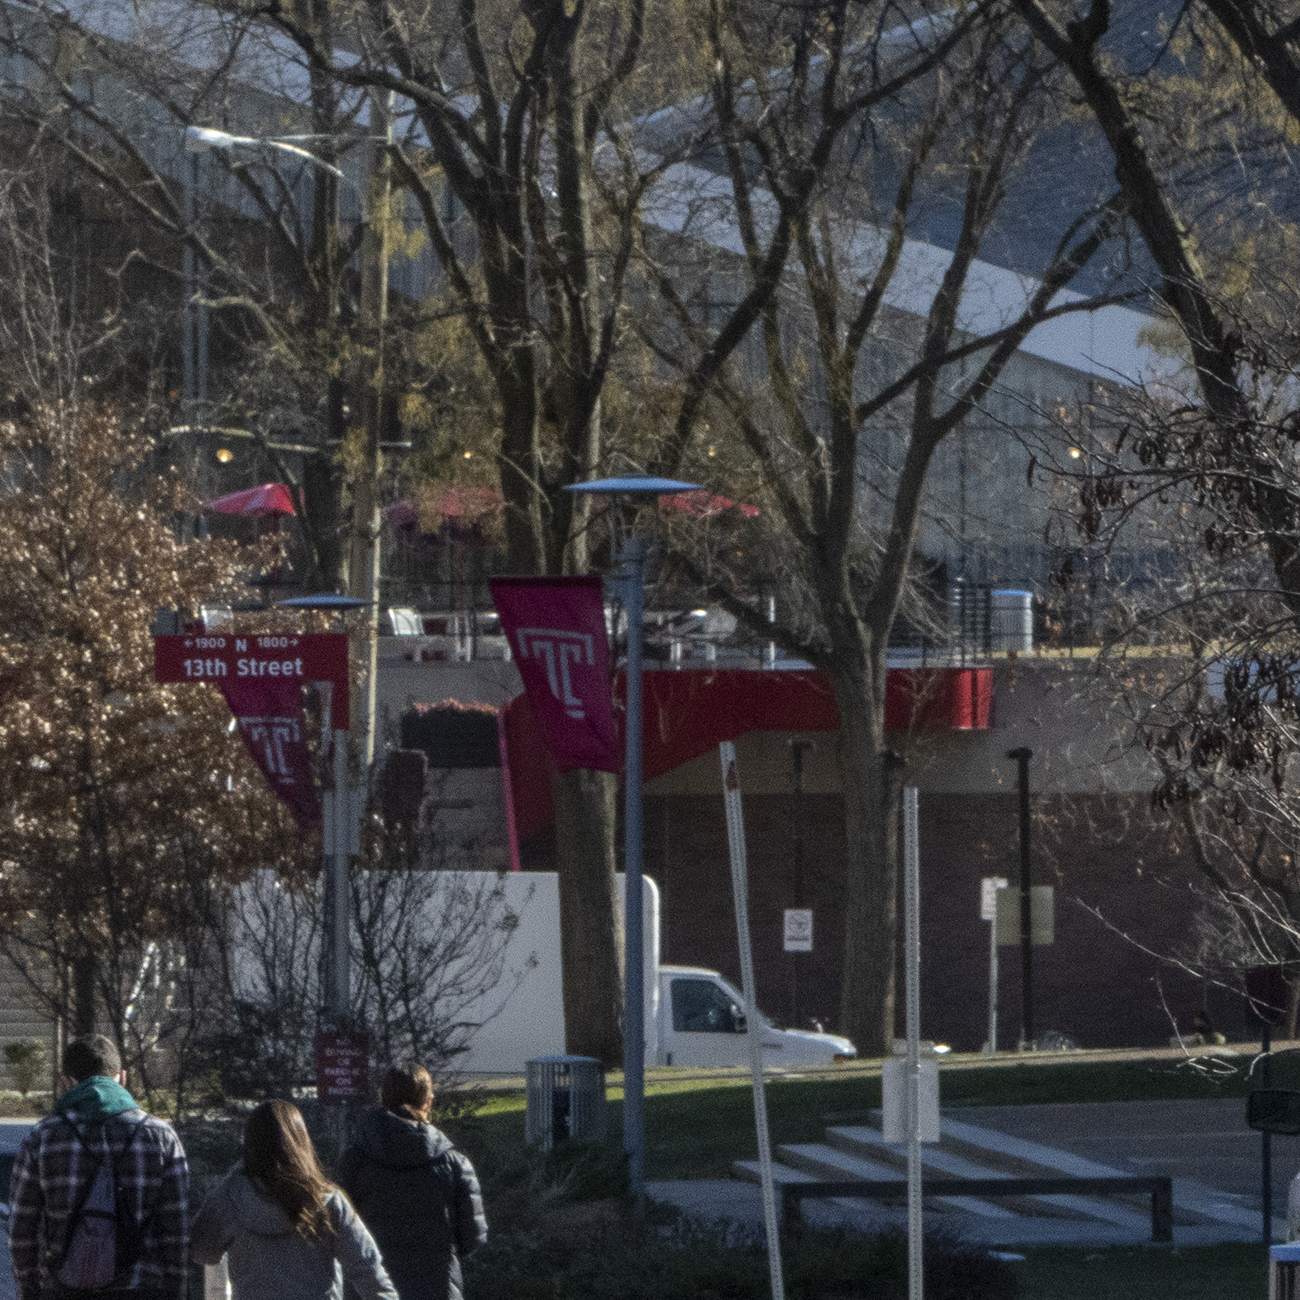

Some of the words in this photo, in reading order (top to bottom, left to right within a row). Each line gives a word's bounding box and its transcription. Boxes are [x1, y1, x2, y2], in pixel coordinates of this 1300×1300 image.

[195, 637, 226, 649] 1900
[236, 639, 248, 652] N
[257, 637, 288, 648] 1800
[183, 658, 227, 677] 13th
[237, 657, 303, 677] Street
